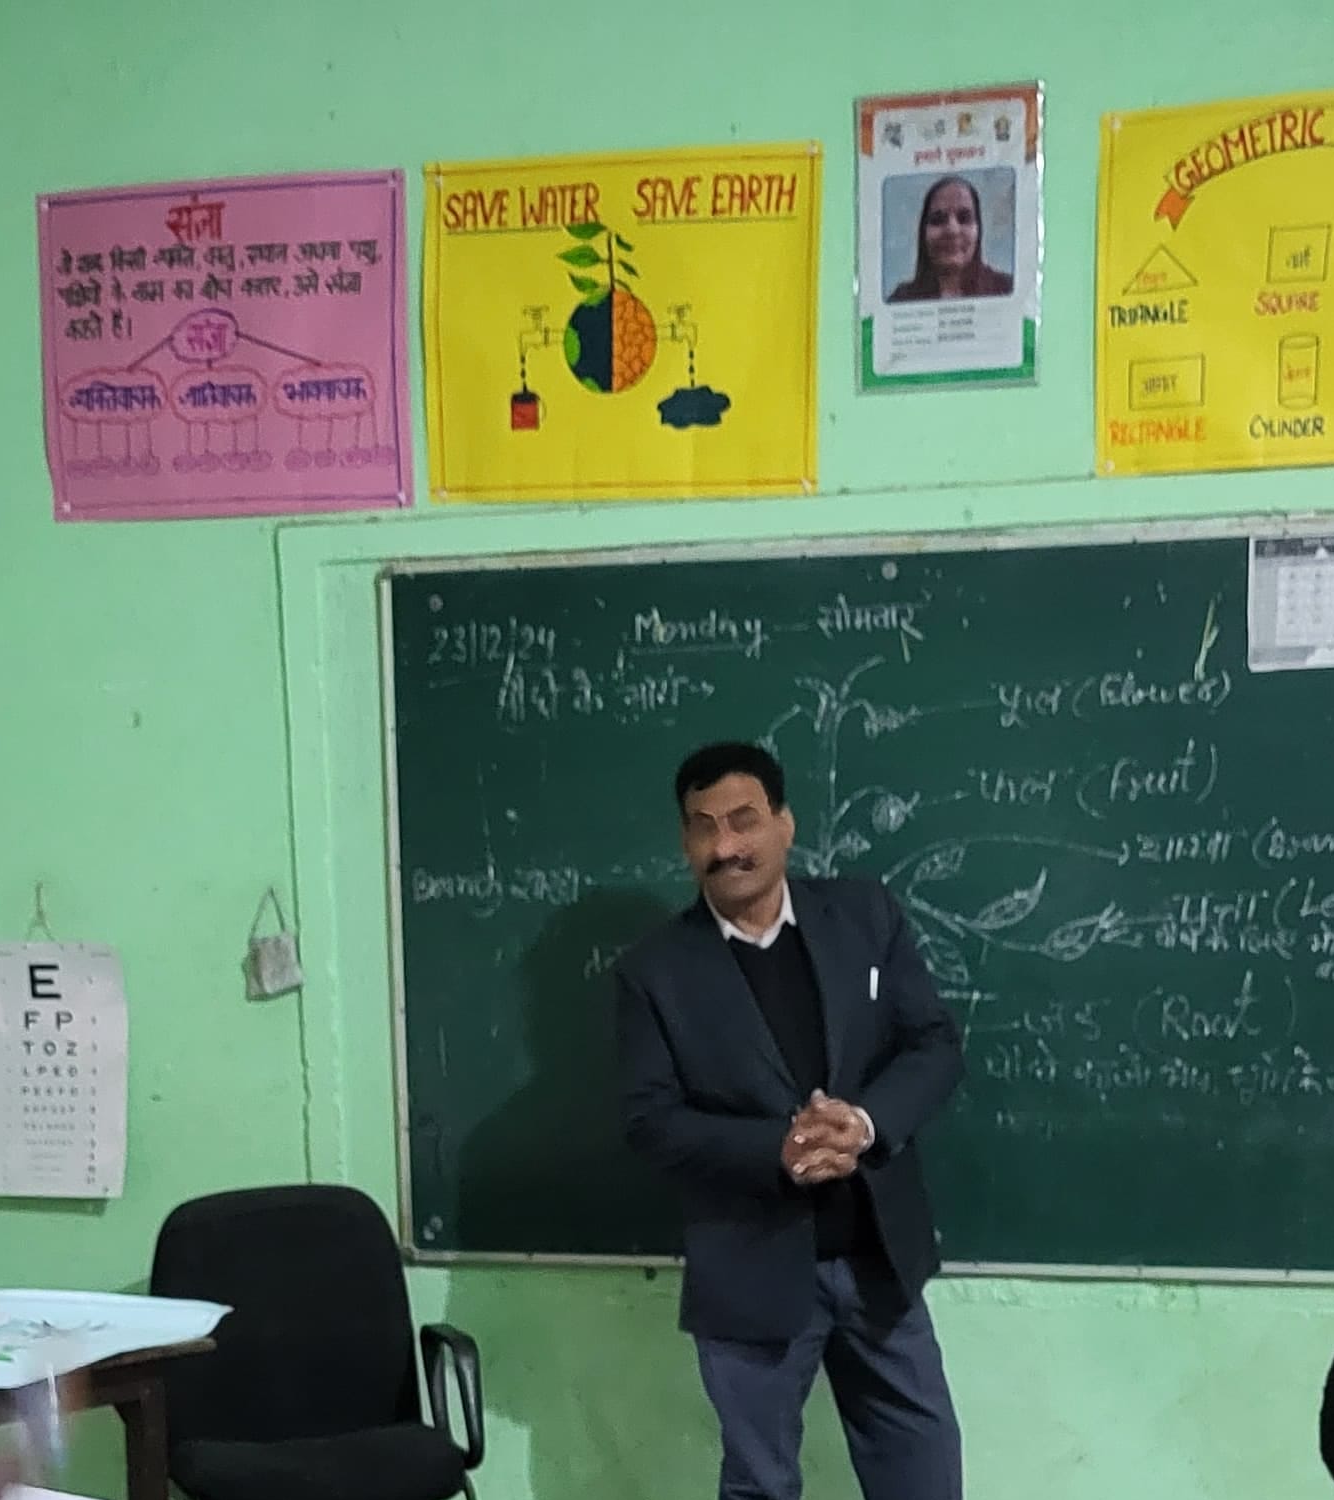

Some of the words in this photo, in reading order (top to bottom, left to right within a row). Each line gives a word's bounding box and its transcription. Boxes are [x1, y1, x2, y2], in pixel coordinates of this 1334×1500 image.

[1172, 106, 1326, 193] GEOMETRIC
[443, 189, 510, 230] SAVE
[519, 182, 601, 227] WATER
[633, 176, 702, 219] SAVE
[711, 173, 798, 217] EARTH
[1254, 290, 1321, 317] SQUARE
[1249, 415, 1326, 441] CYLINDER
[633, 606, 768, 660] Monday
[29, 964, 62, 999] E
